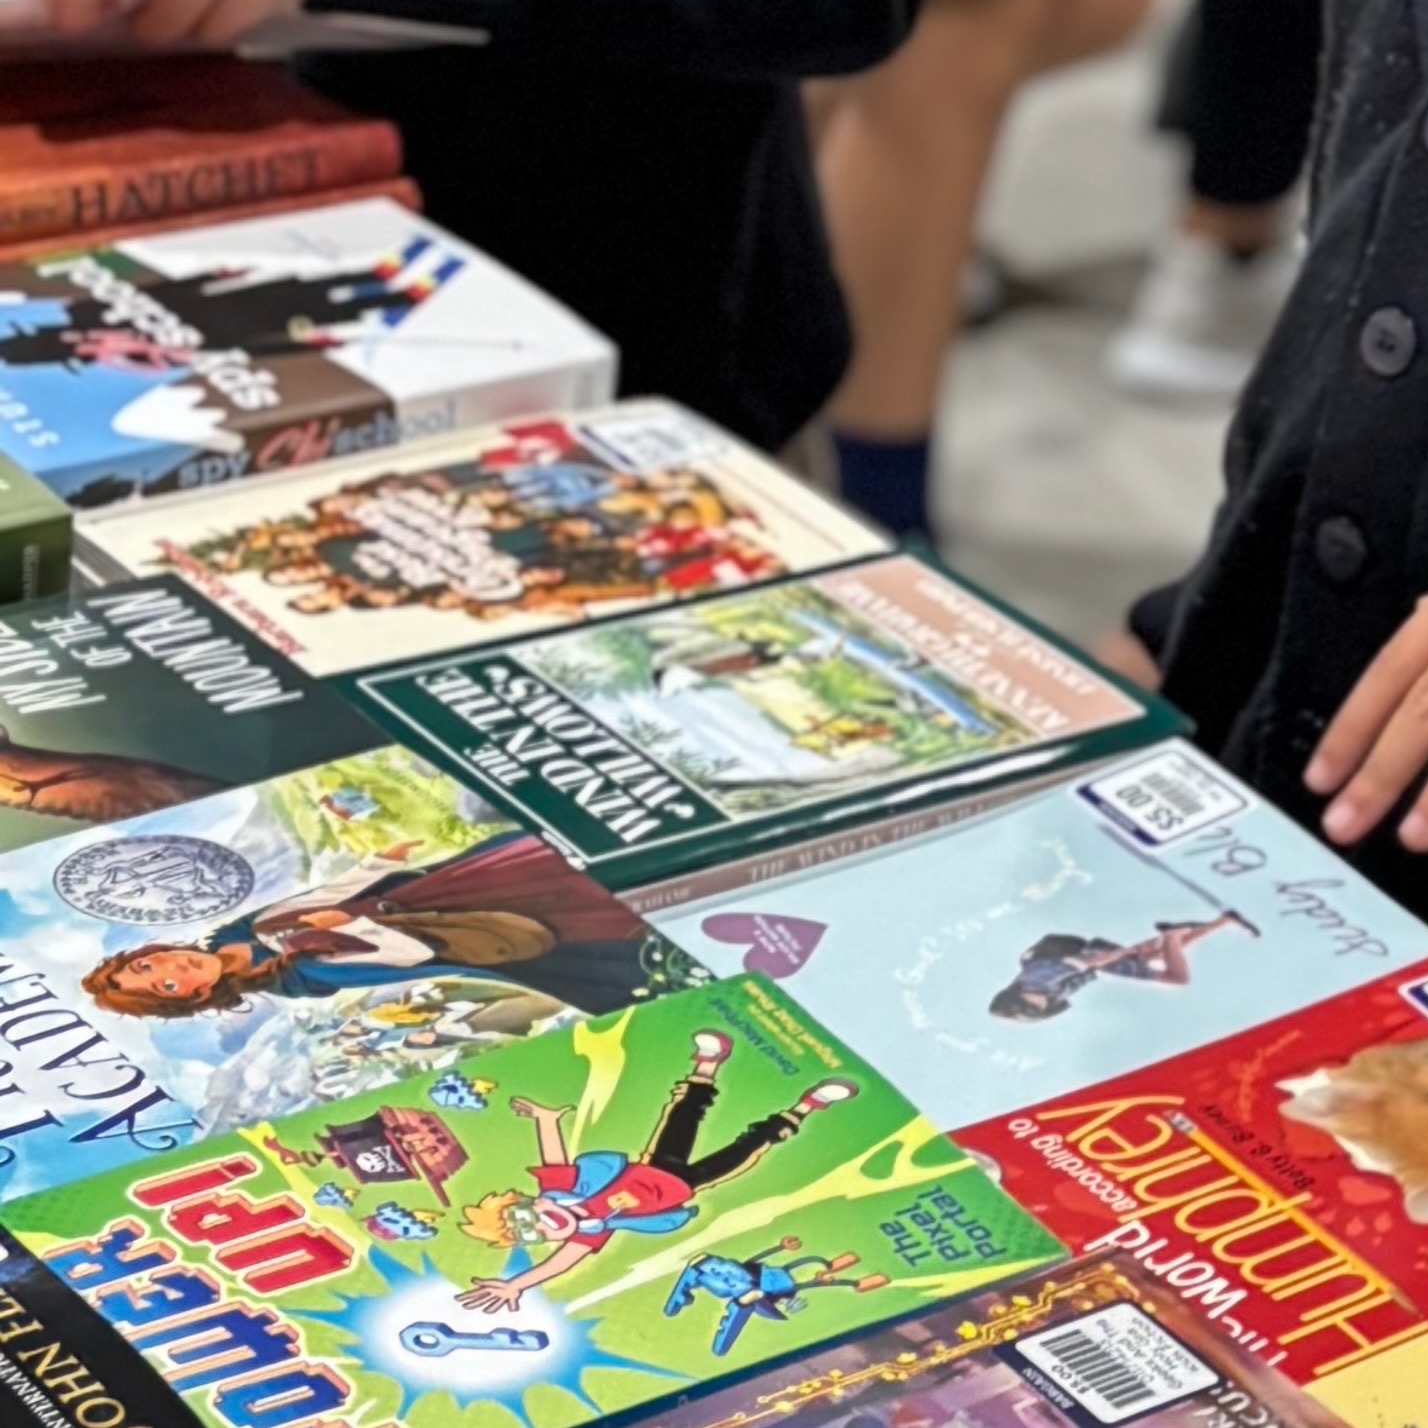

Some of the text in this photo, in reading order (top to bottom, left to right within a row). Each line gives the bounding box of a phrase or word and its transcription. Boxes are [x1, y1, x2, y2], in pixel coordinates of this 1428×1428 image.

[71, 151, 319, 225] HATCHET
[178, 450, 249, 489] spy
[334, 403, 456, 459] school
[31, 609, 132, 668] OF THE
[87, 587, 303, 714] MOUNTAIN
[0, 676, 106, 714] MY
[417, 667, 663, 843] WIND IN THE
[465, 746, 529, 786] THE
[504, 678, 685, 807] WILLOWS
[1114, 785, 1185, 828] $5.00
[749, 860, 785, 882] THE
[800, 841, 856, 871] WIND
[861, 834, 881, 852] IN
[1275, 878, 1389, 959] Judy
[765, 1047, 801, 1076] David
[1005, 1117, 1137, 1214] according to
[1264, 1156, 1314, 1191] Betty
[131, 1155, 355, 1292] UP!
[880, 1222, 933, 1266] The
[907, 1205, 971, 1264] Pixel
[928, 1186, 1005, 1263] Portal
[1085, 1220, 1249, 1320] World
[1051, 1365, 1089, 1394] $5.00
[1117, 1338, 1147, 1359] And
[0, 1351, 74, 1428] NTERNATI
[20, 1336, 155, 1428] OHN
[1022, 1367, 1075, 1409] BARGAIN
